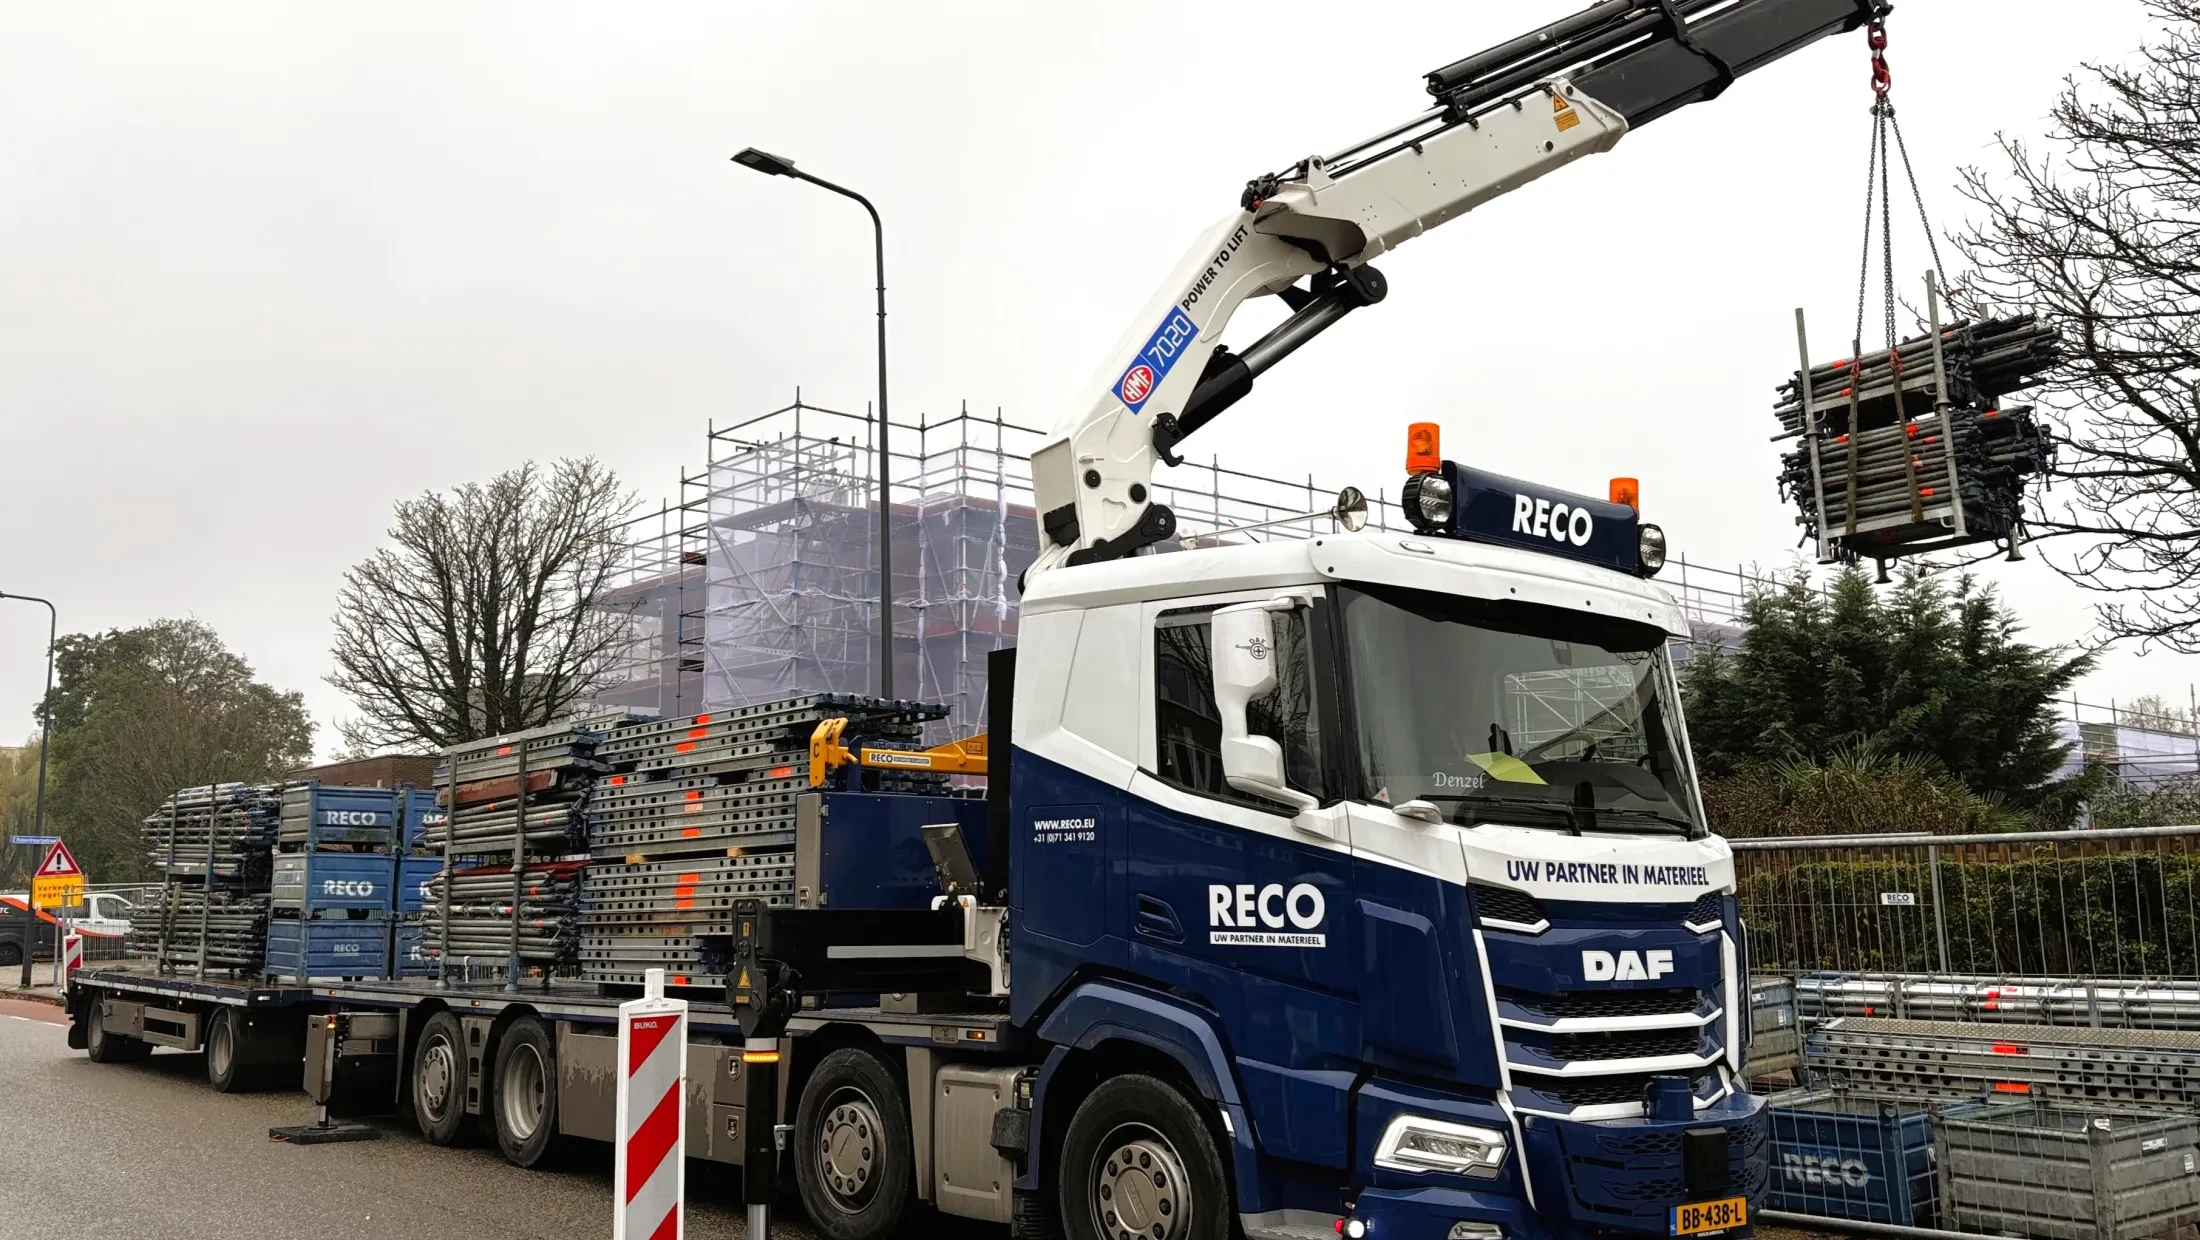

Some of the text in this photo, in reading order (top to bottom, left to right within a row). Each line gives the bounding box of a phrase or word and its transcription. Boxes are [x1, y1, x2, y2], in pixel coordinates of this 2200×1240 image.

[1181, 224, 1248, 312] POWER TO LIFT
[1124, 314, 1191, 401] HMF 7020
[1512, 493, 1593, 547] RECO
[1248, 636, 1267, 644] DAF
[870, 753, 893, 763] RECO
[1432, 771, 1486, 789] Denzel
[326, 810, 377, 826] RECO
[1034, 818, 1095, 831] WWW.RECO.EU
[1033, 831, 1095, 844] +31 (0)71 341 9120
[1506, 860, 1710, 886] UW PARTNER IN MATERIEEL
[323, 879, 374, 897] RECO
[1208, 883, 1326, 930] RECO
[1886, 894, 1910, 902] RECO
[333, 943, 360, 952] RECO
[1214, 934, 1321, 945] UW PARTNER IN MATERIEEL
[1581, 949, 1675, 982] DAF
[1783, 1152, 1870, 1188] RECO
[1682, 1201, 1743, 1231] BB-438-L
